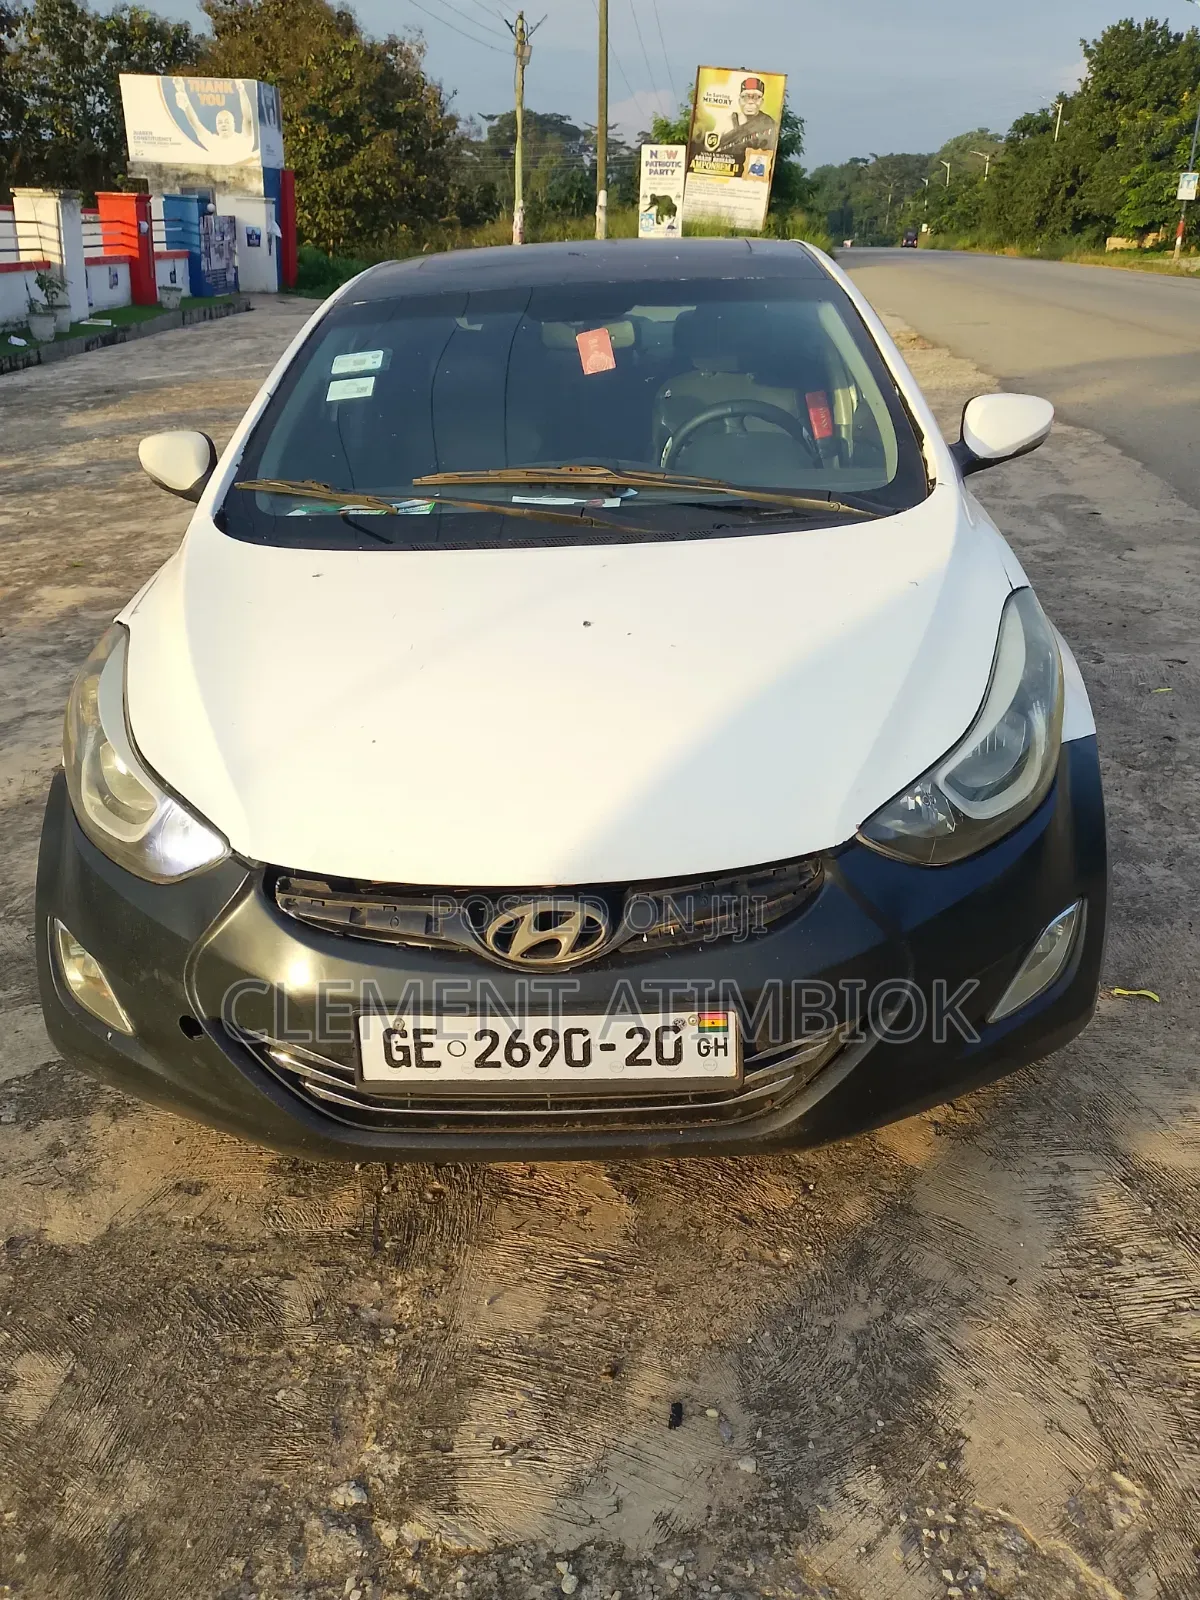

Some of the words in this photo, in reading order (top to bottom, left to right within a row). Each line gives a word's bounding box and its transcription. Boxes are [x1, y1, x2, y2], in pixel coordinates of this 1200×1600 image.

[189, 80, 233, 94] THANK
[199, 94, 226, 107] YOU
[702, 97, 733, 105] MEMORY
[649, 149, 678, 159] NEW
[645, 160, 682, 168] PATRIOTIC
[648, 168, 676, 176] PARTY
[382, 1028, 442, 1069] GE
[474, 1025, 683, 1068] 2690-20
[697, 1036, 729, 1058] GH
